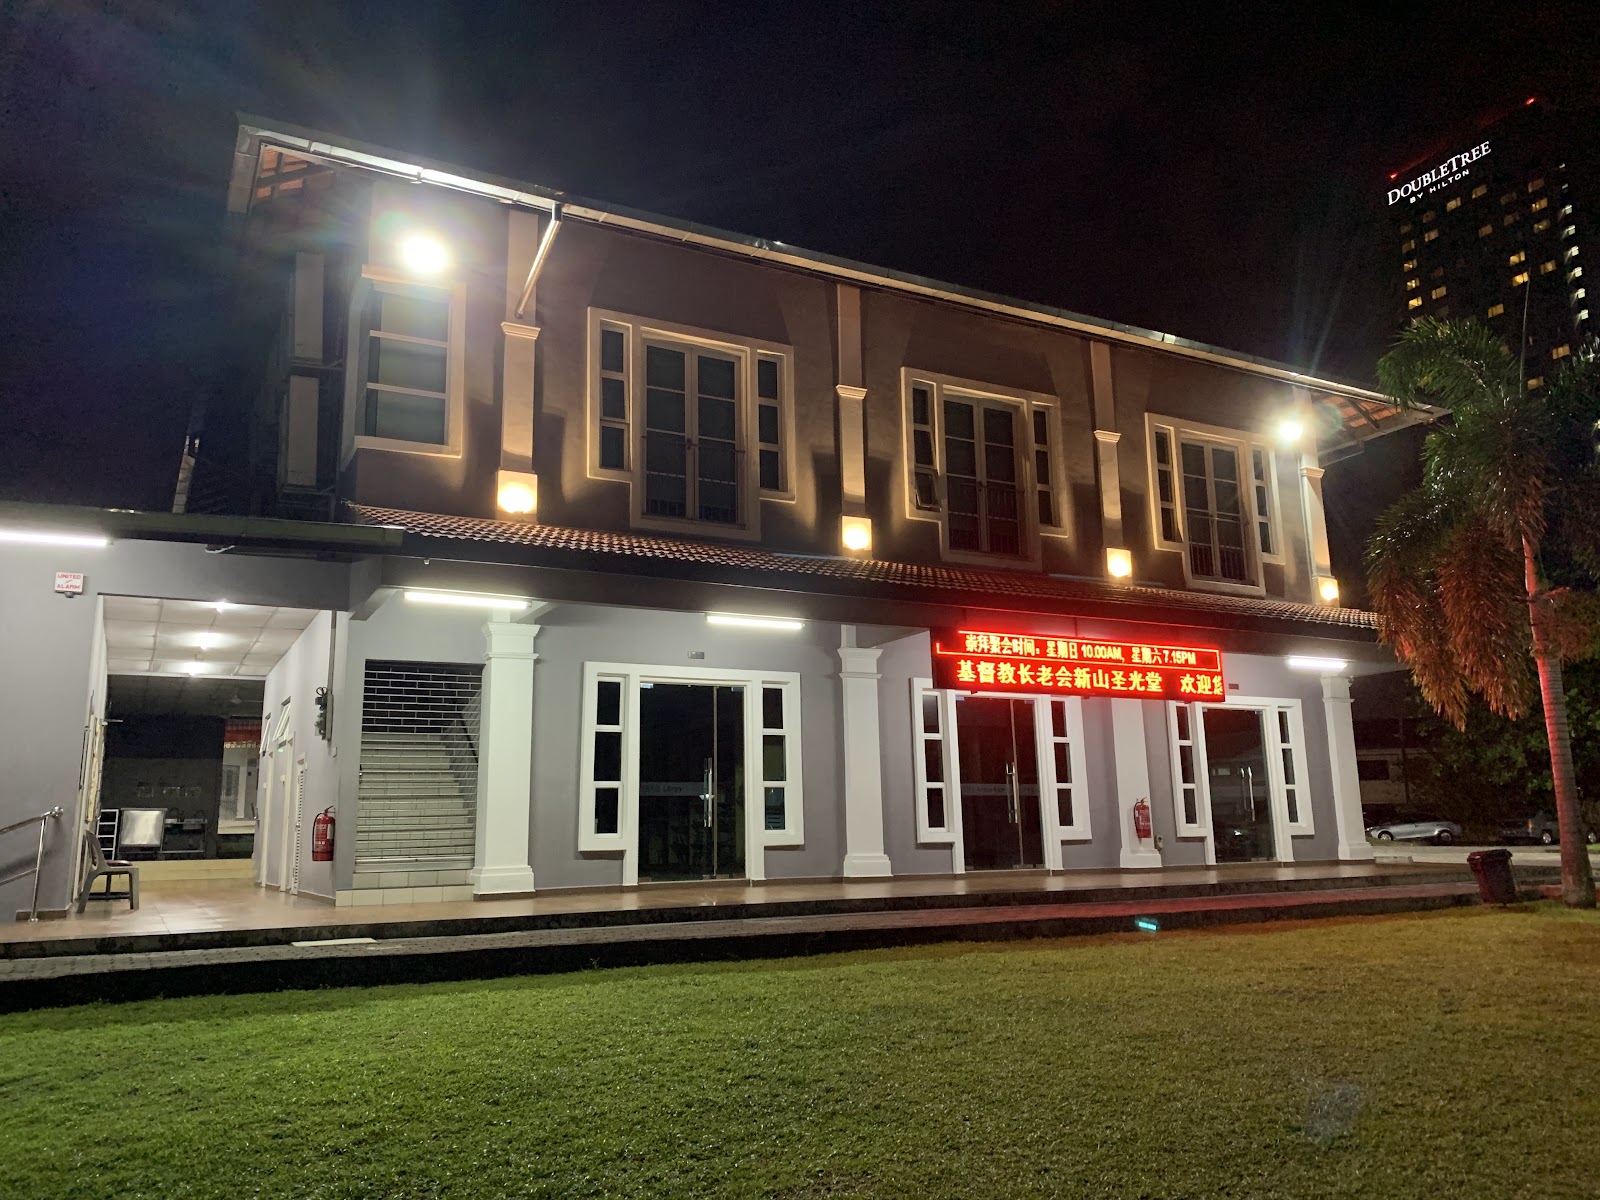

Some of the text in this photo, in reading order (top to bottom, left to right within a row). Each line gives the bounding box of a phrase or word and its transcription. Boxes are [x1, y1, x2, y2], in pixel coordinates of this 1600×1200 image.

[1387, 141, 1492, 206] DOUBLETREE
[1410, 169, 1470, 204] BY HILTON
[957, 659, 1163, 693] 基督教长老会新山圣光堂
